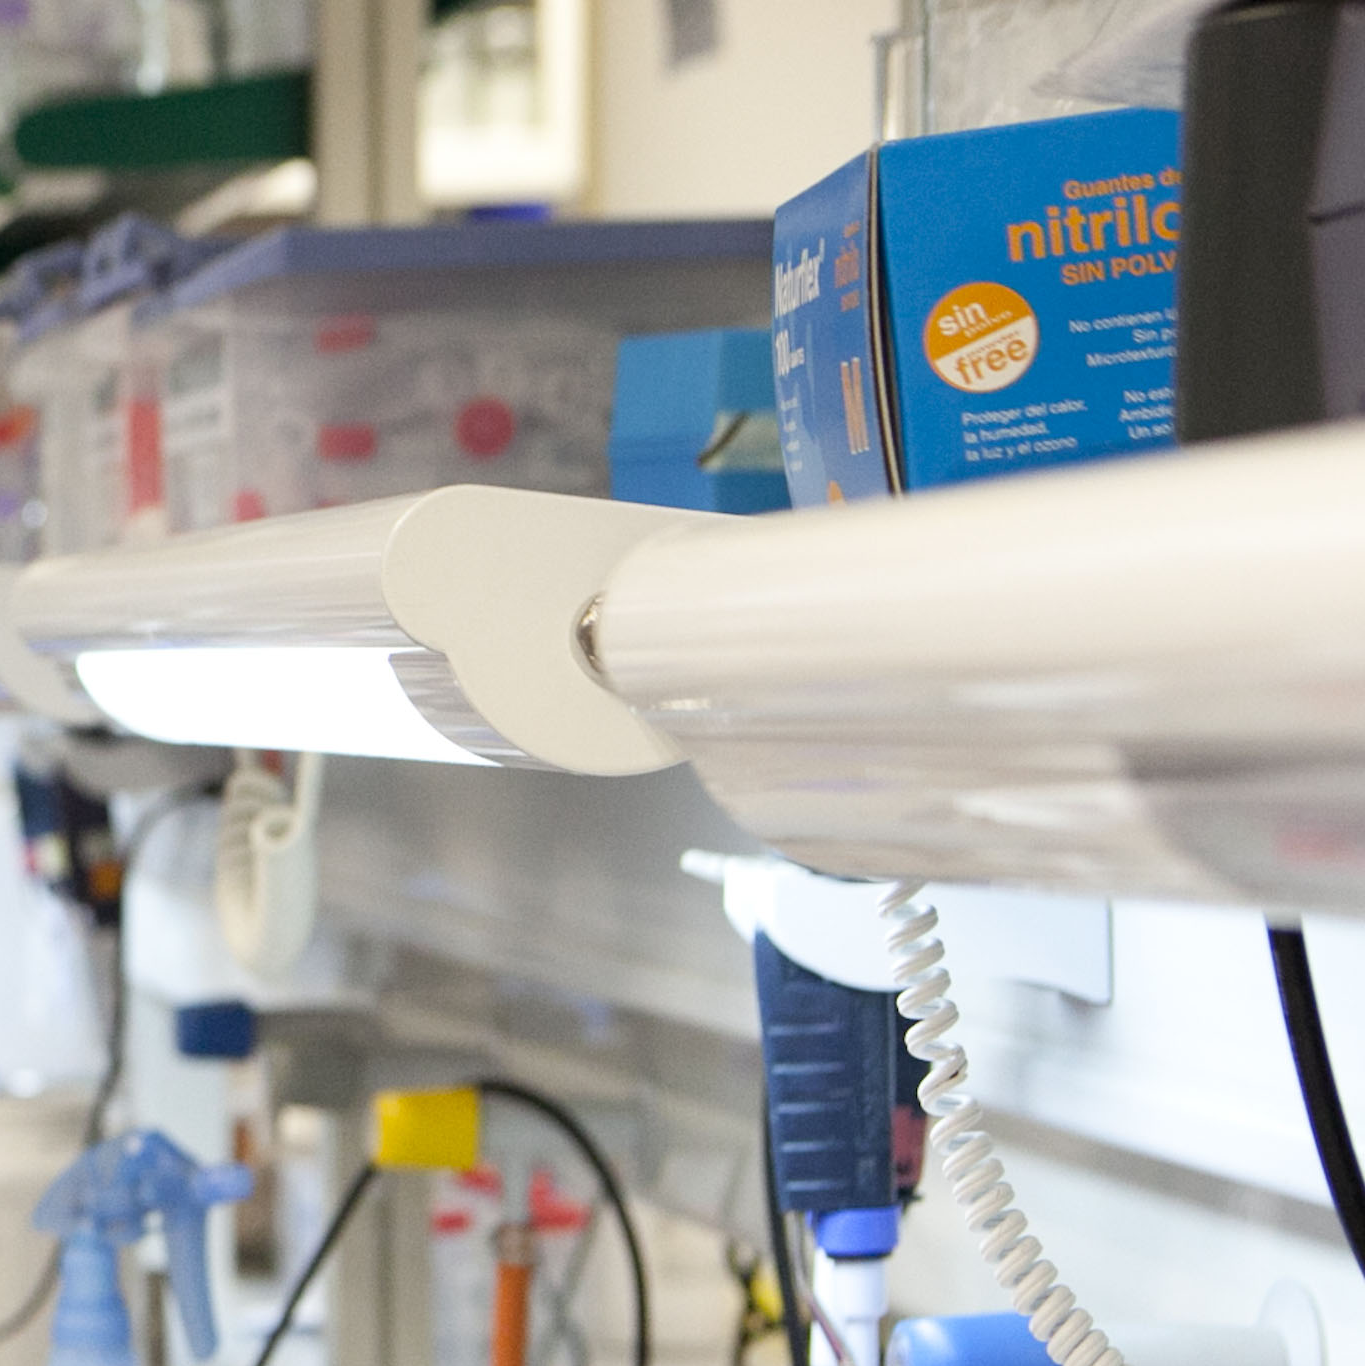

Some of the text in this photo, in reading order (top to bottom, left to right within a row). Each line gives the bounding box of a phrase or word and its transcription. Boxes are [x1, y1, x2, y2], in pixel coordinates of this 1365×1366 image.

[1063, 171, 1155, 200] Guantes
[1061, 250, 1178, 286] SIN POLV
[937, 302, 987, 337] sin
[954, 339, 1030, 385] free
